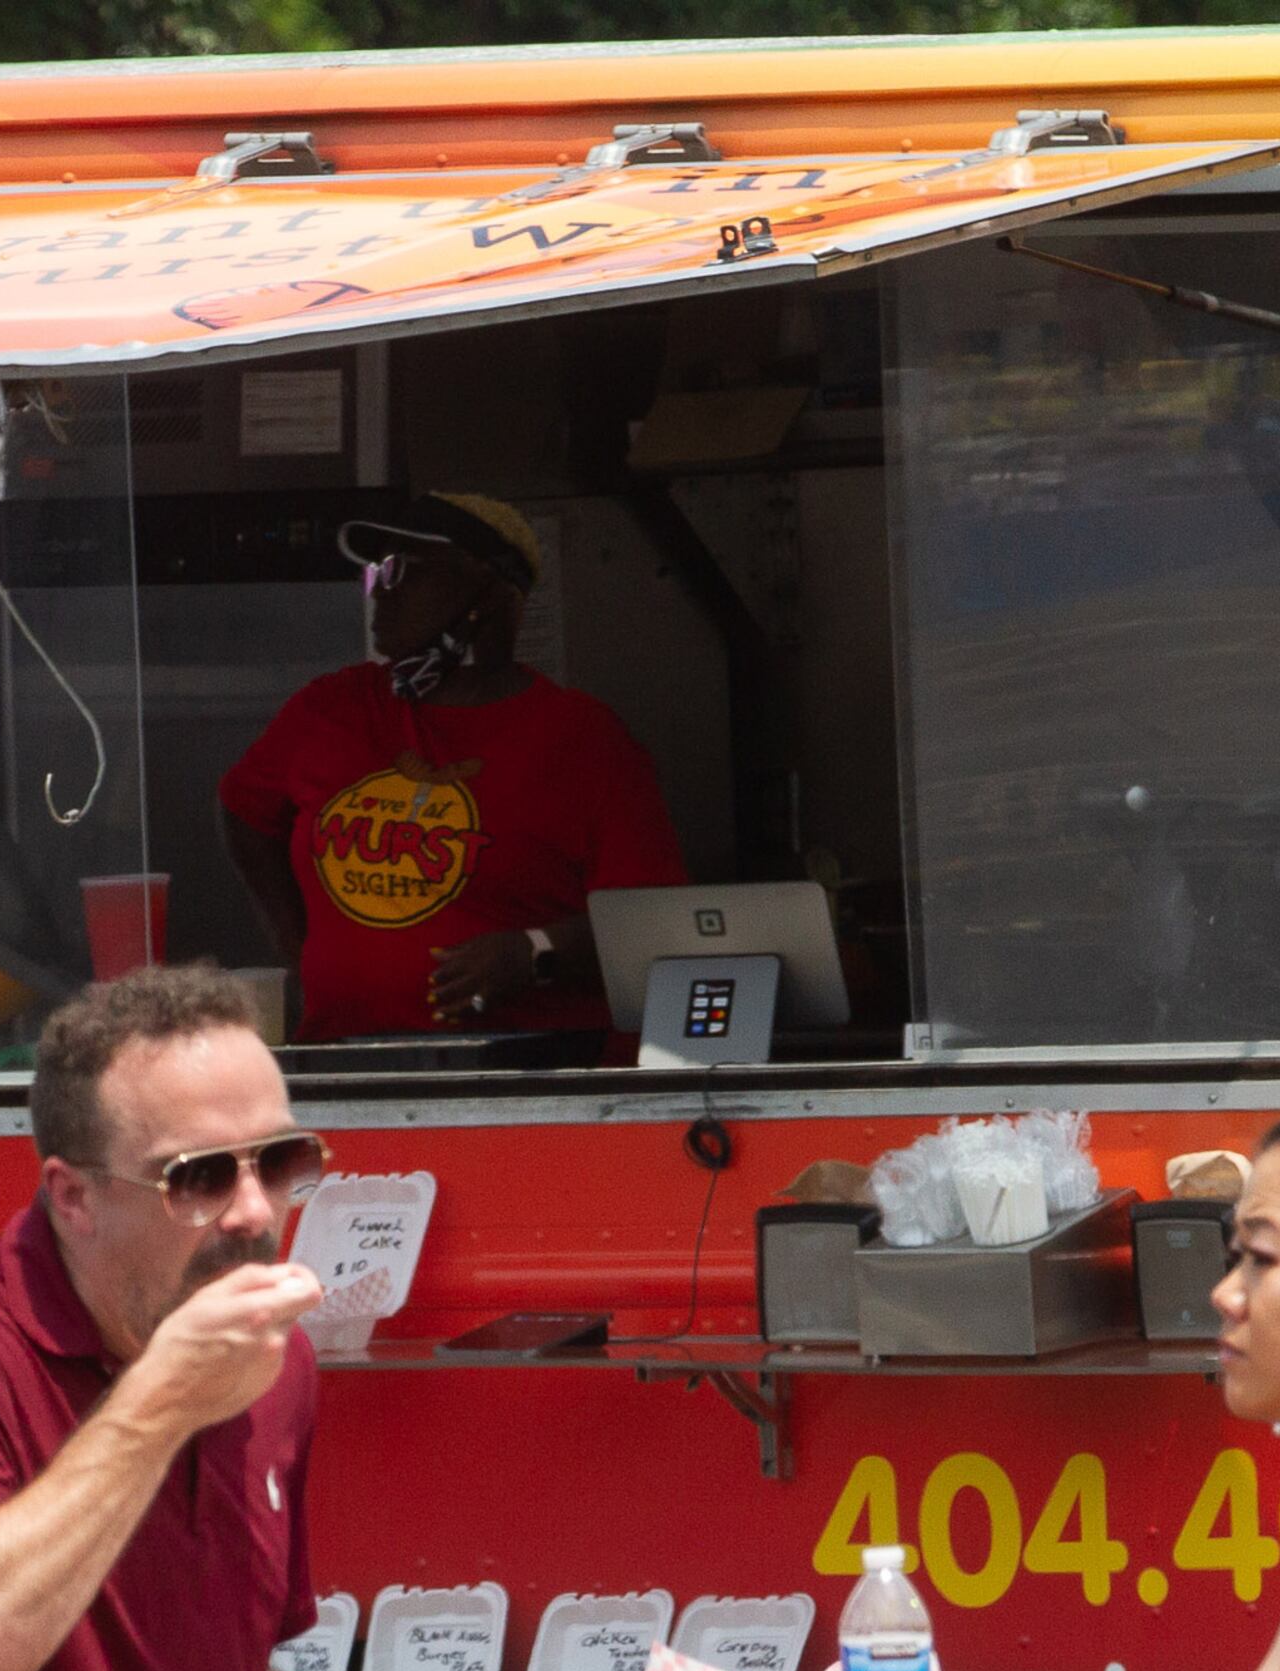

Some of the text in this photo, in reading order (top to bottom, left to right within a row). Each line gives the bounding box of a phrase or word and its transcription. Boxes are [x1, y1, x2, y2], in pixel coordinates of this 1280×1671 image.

[422, 800, 453, 820] at
[312, 813, 494, 884] WURST
[341, 869, 432, 898] SIGHT
